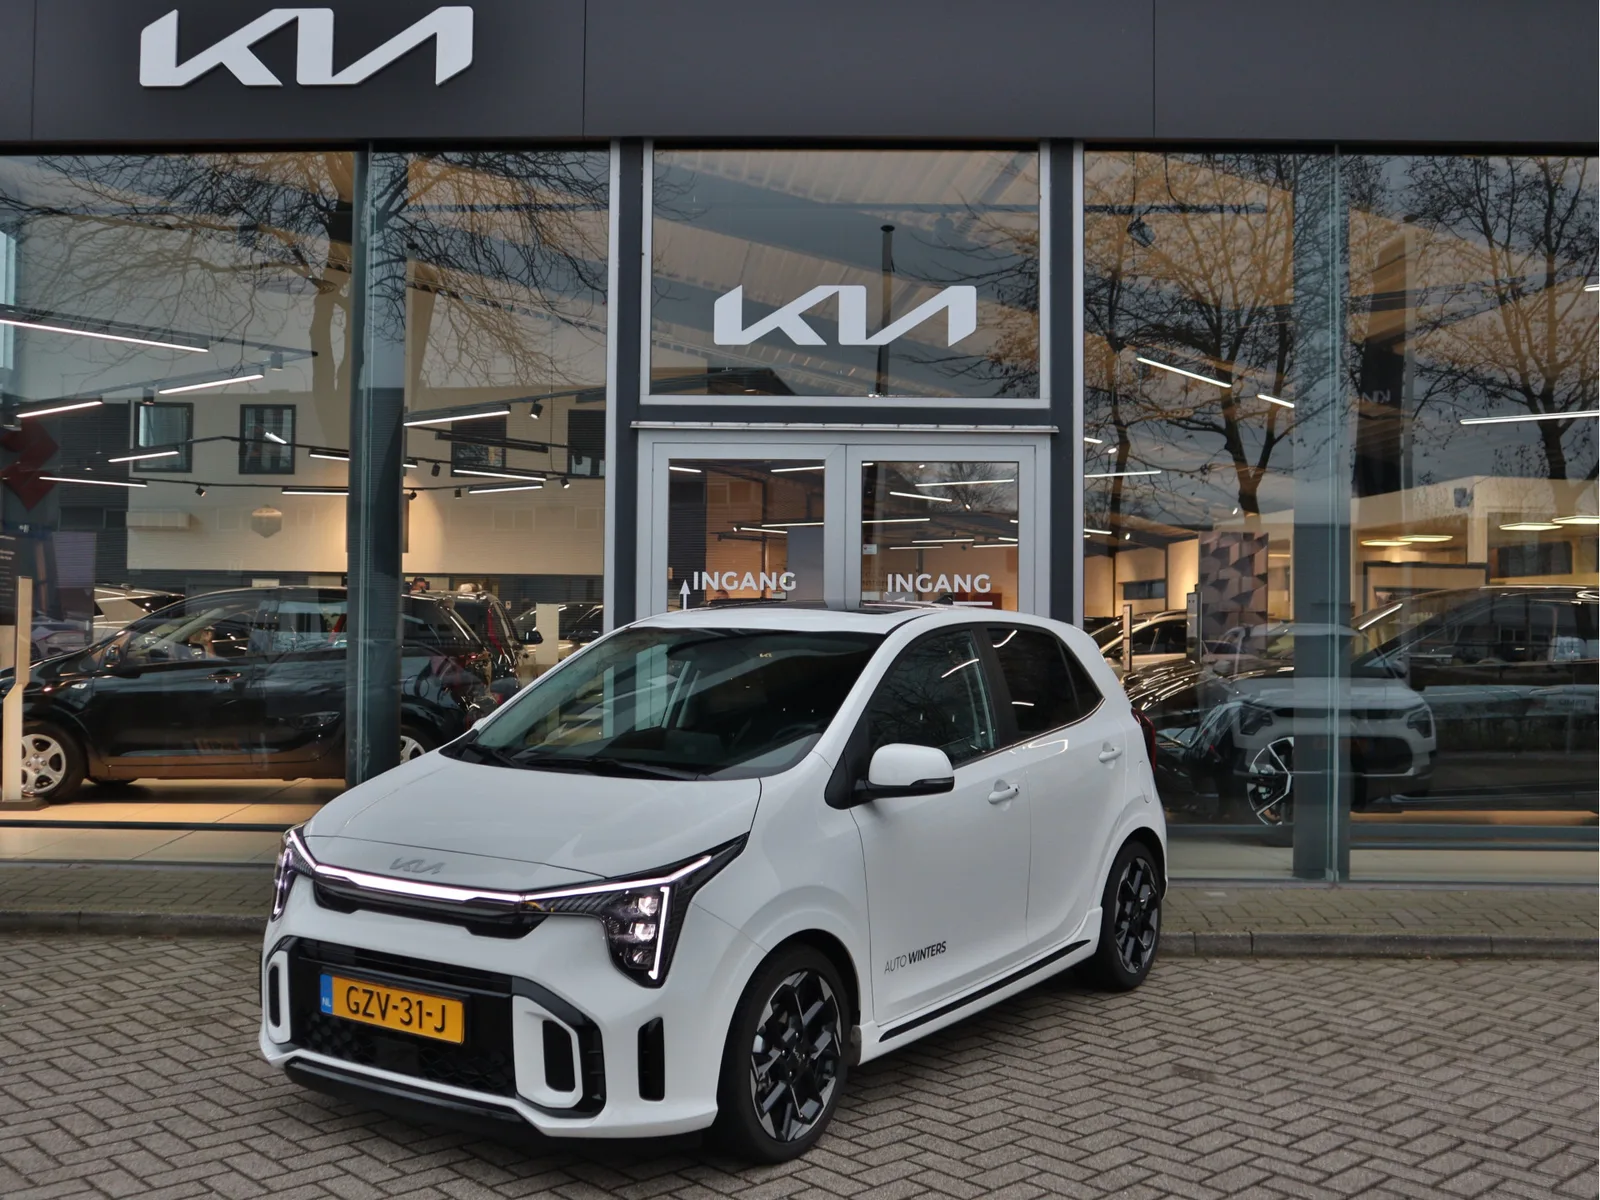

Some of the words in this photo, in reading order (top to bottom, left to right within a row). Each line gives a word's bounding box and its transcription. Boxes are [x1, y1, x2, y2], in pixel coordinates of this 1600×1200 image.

[140, 6, 474, 87] KIA
[714, 285, 977, 347] KIA
[693, 571, 797, 591] INGANG
[887, 573, 991, 593] INGANG
[389, 857, 446, 875] KIA
[884, 954, 908, 975] AUTO
[908, 941, 947, 964] WINTERS
[321, 997, 332, 1008] NL
[346, 985, 447, 1033] GZV-31-J
